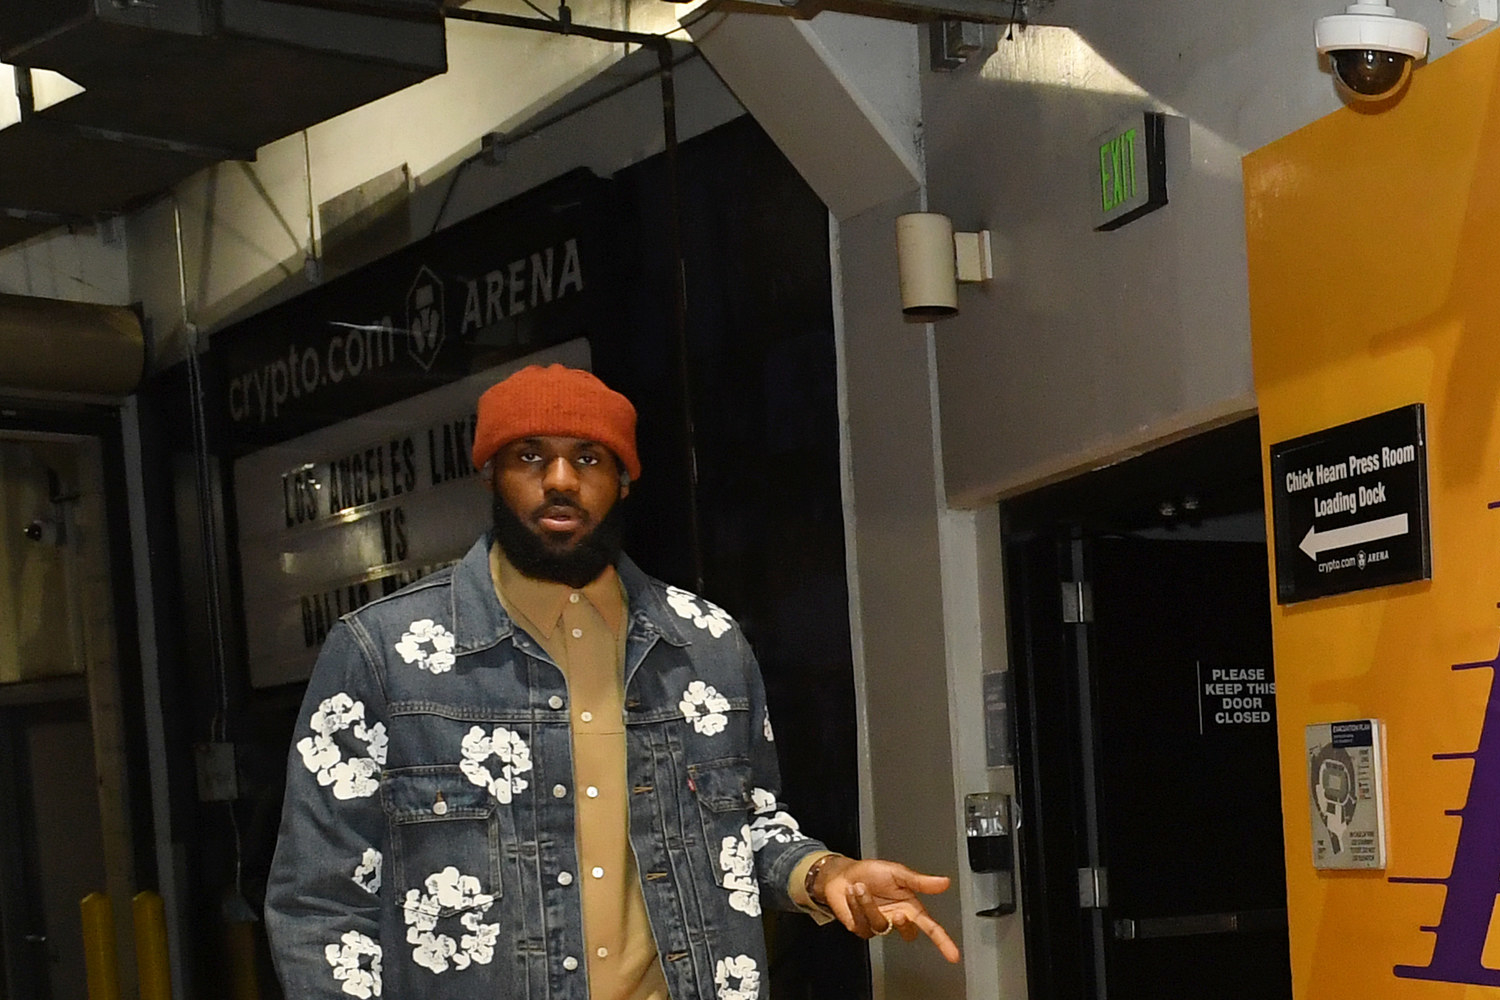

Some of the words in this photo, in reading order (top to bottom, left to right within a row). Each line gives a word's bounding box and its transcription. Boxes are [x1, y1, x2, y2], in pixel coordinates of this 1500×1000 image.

[1100, 129, 1136, 212] EXIT
[229, 313, 396, 423] crypto.com
[461, 238, 584, 335] ARENA
[283, 467, 319, 528] LOS
[329, 436, 416, 515] ANGELES
[1286, 467, 1315, 493] Chick
[1316, 462, 1347, 486] Hearn
[1349, 452, 1380, 477] Press
[1382, 444, 1415, 468] Room
[1314, 491, 1357, 518] Loading
[1358, 481, 1387, 507] Dock
[380, 506, 410, 564] VS
[1318, 556, 1356, 573] crypto.com
[1367, 550, 1389, 563] ARENA
[1205, 683, 1243, 695] KEEP
[1246, 682, 1276, 695] THIS
[1212, 669, 1265, 681] PLEASE
[1215, 711, 1271, 724] CLOSED
[1222, 697, 1262, 709] DOOR
